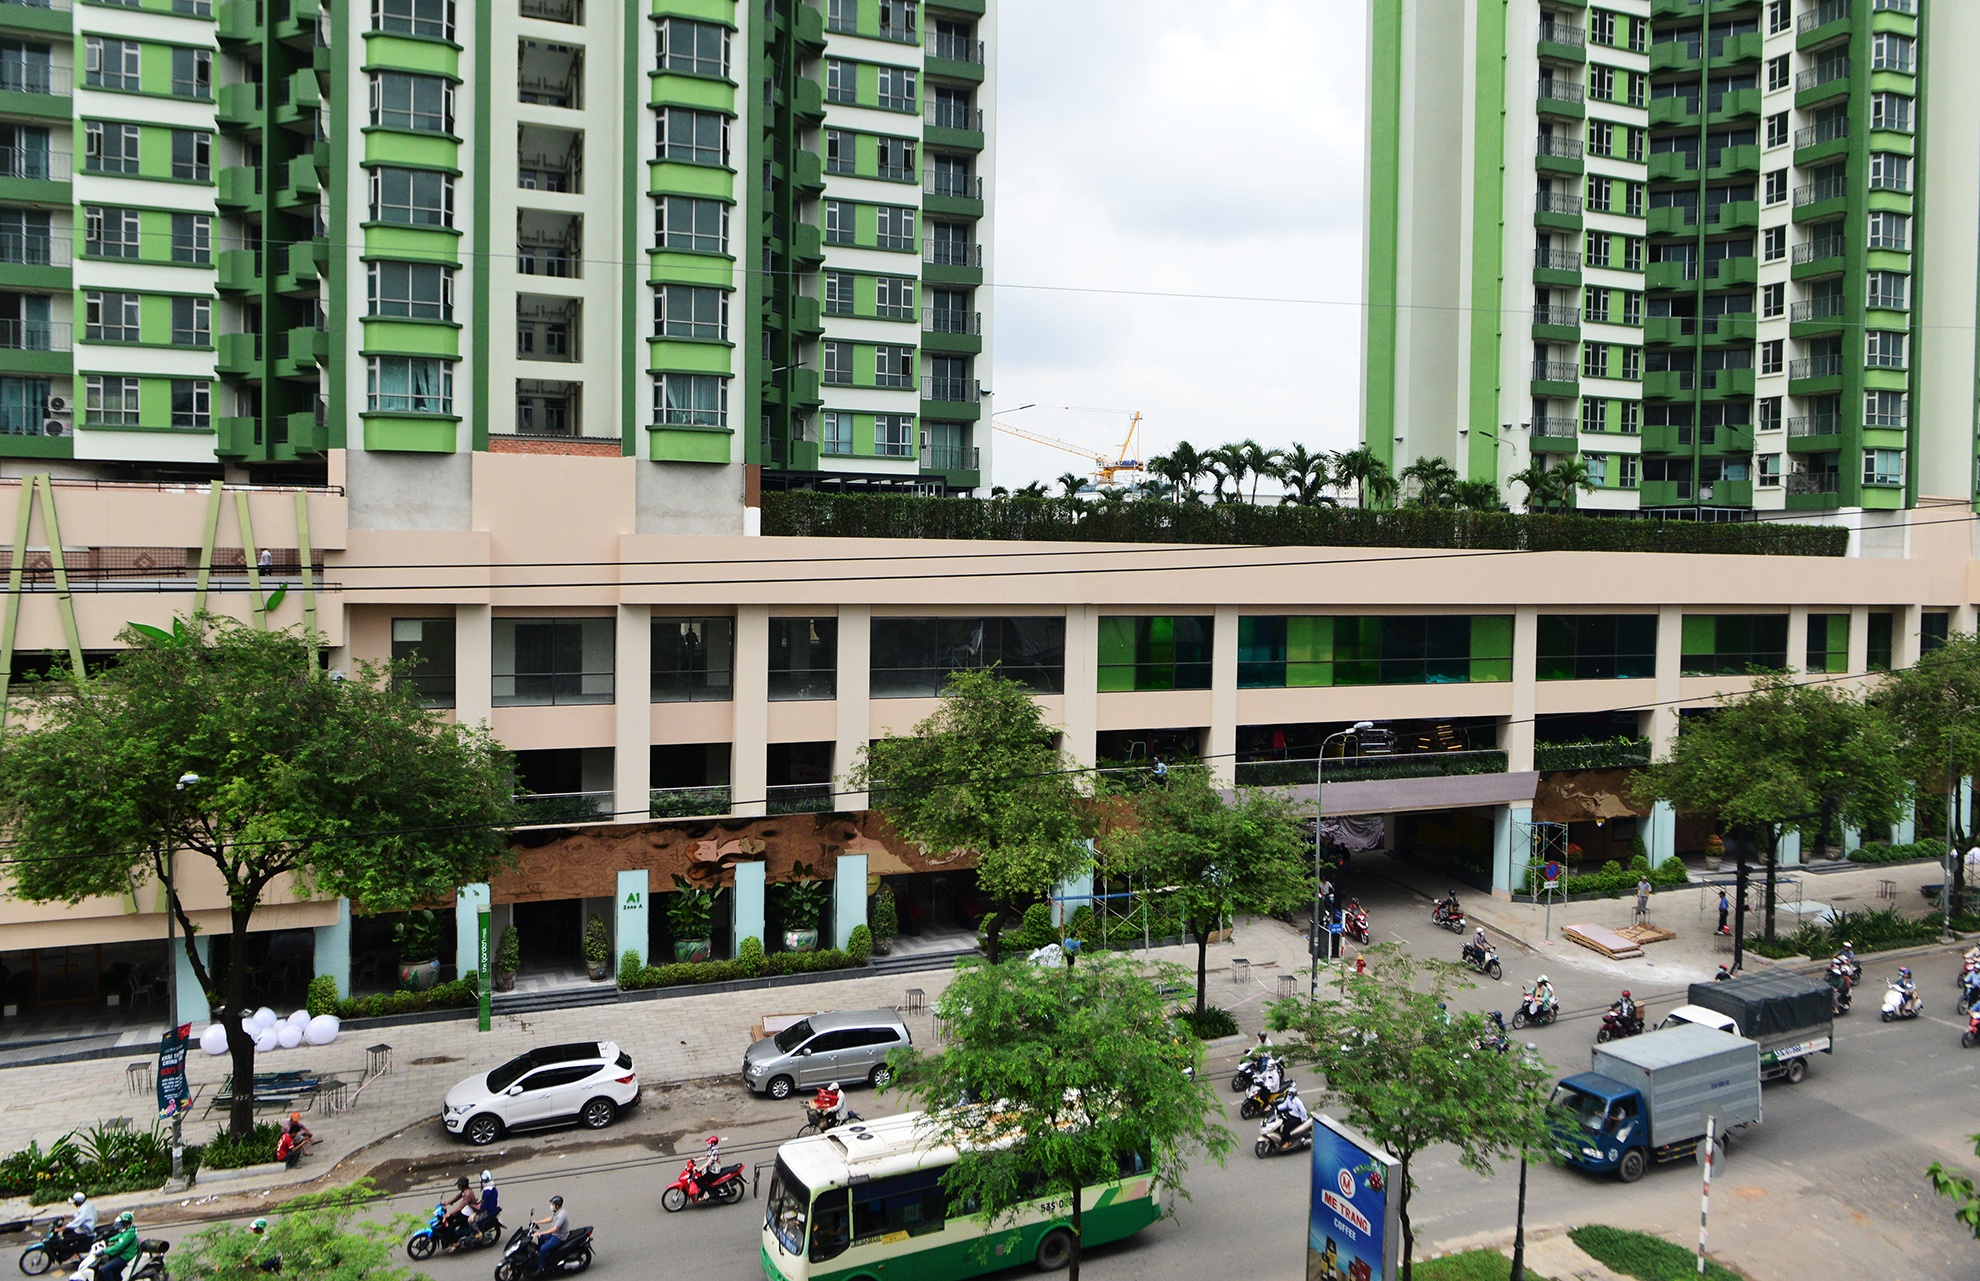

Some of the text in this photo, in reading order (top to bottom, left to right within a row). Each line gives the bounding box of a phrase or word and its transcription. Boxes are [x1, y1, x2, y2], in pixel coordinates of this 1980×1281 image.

[626, 892, 641, 904] A1
[1333, 1217, 1357, 1241] COFFEE
[1339, 1202, 1368, 1232] TRANG
